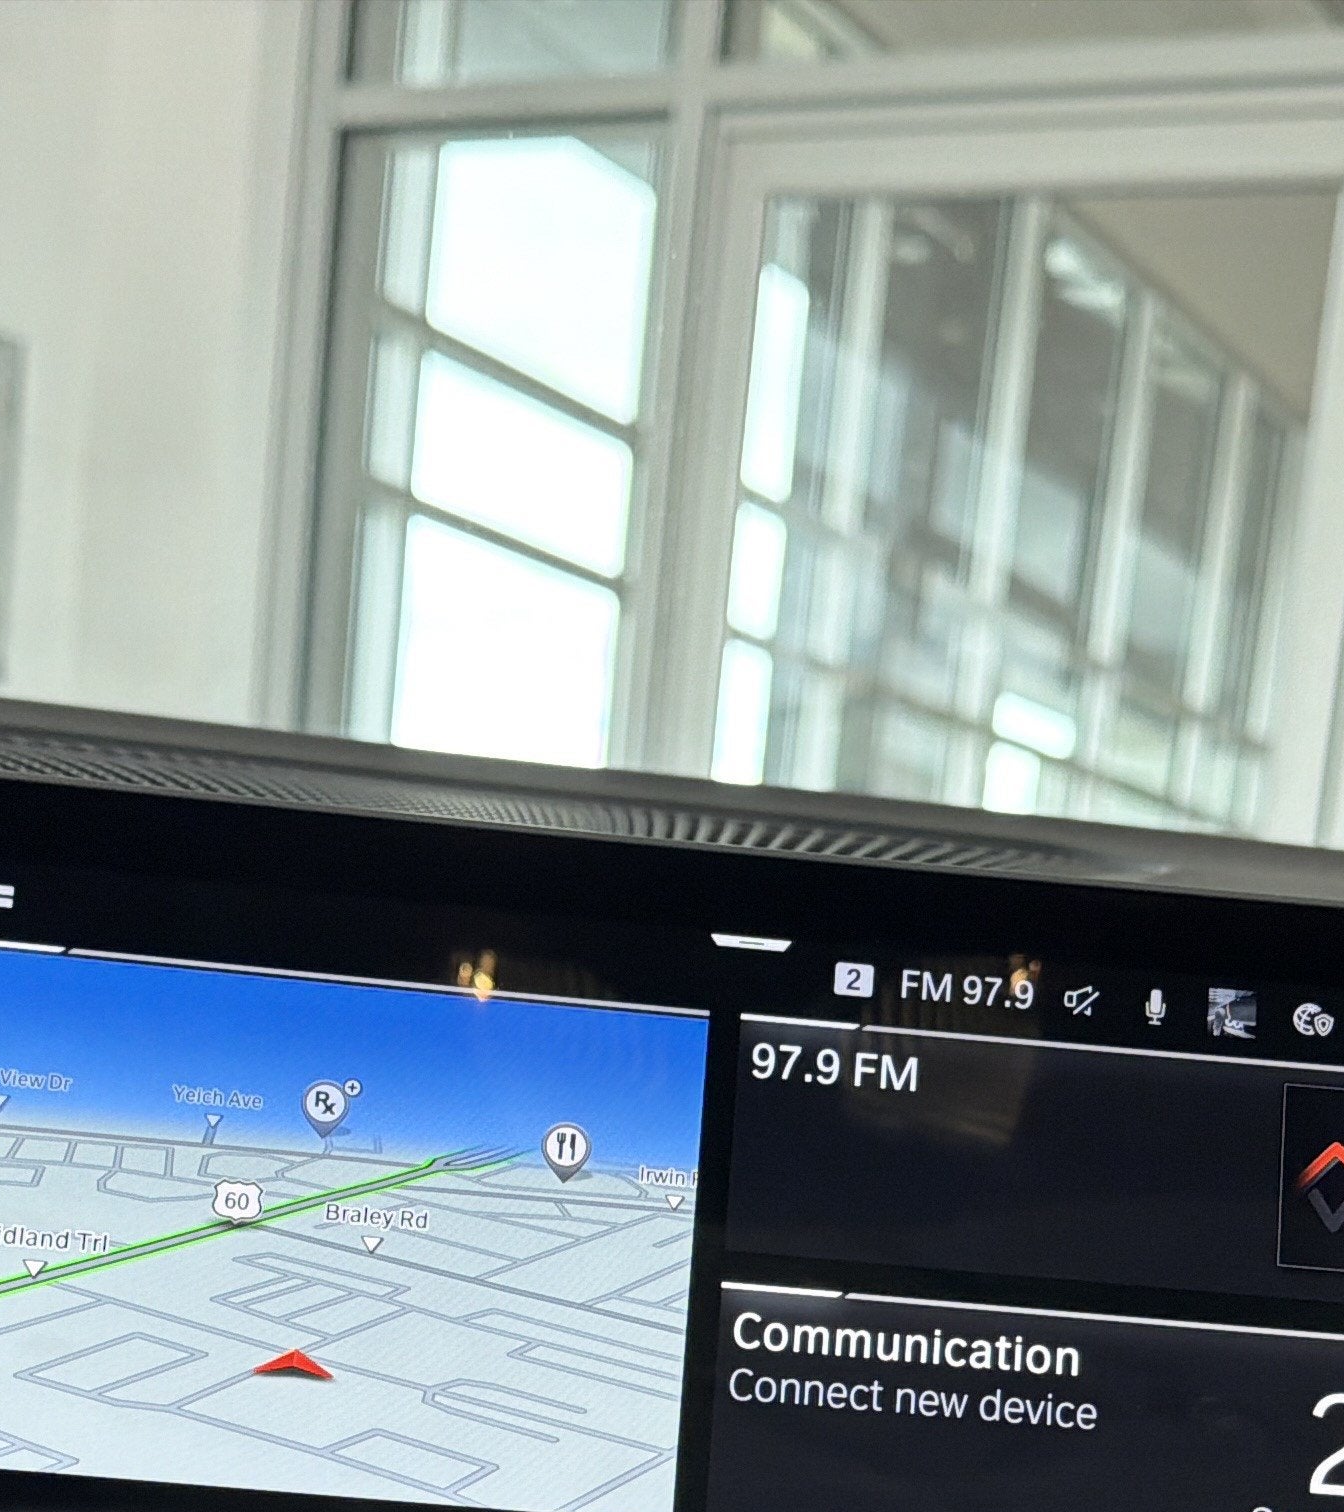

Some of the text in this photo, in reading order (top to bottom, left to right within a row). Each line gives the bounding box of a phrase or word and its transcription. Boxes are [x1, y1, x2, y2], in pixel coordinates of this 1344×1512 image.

[844, 967, 862, 992] 2
[900, 969, 1034, 1011] FM 97.9
[0, 1068, 45, 1088] View
[50, 1074, 72, 1091] Dr
[750, 1042, 919, 1093] 97.9 FM
[228, 1090, 263, 1109] Ave
[640, 1166, 685, 1186] Irwin
[224, 1191, 249, 1210] 60
[325, 1204, 428, 1229] Braley Rd
[77, 1232, 108, 1252] Trl
[732, 1312, 1081, 1377] Communication
[728, 1367, 1099, 1431] Connect new device
